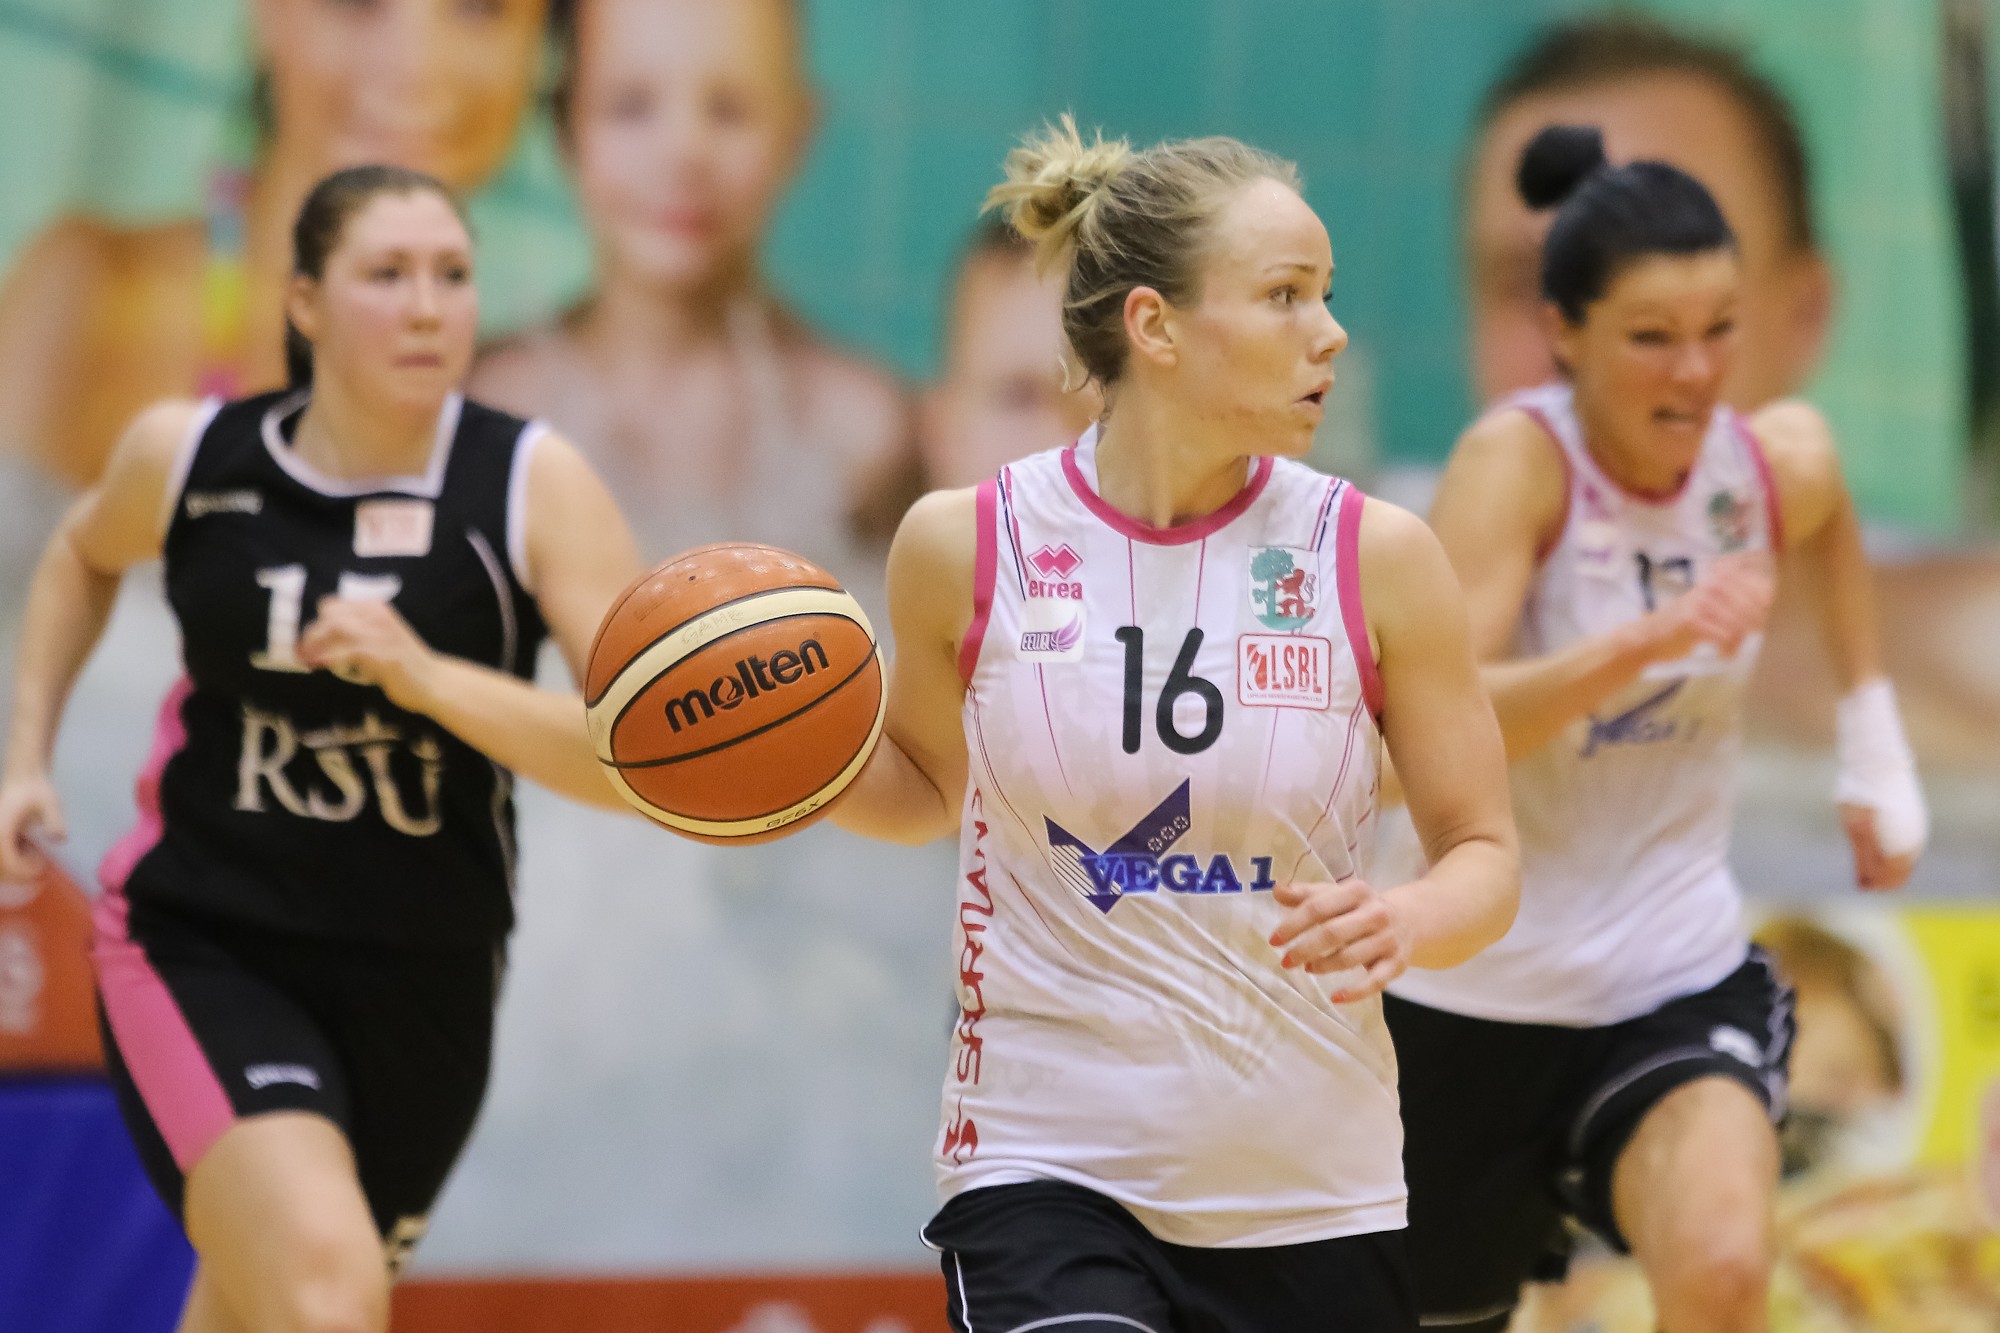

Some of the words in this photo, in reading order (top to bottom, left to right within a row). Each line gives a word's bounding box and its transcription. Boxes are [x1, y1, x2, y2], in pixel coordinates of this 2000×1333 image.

[664, 638, 830, 734] molten
[1114, 626, 1224, 755] 16
[1270, 643, 1323, 694] LSBL
[1079, 852, 1243, 894] VEGA
[1250, 855, 1276, 892] 1
